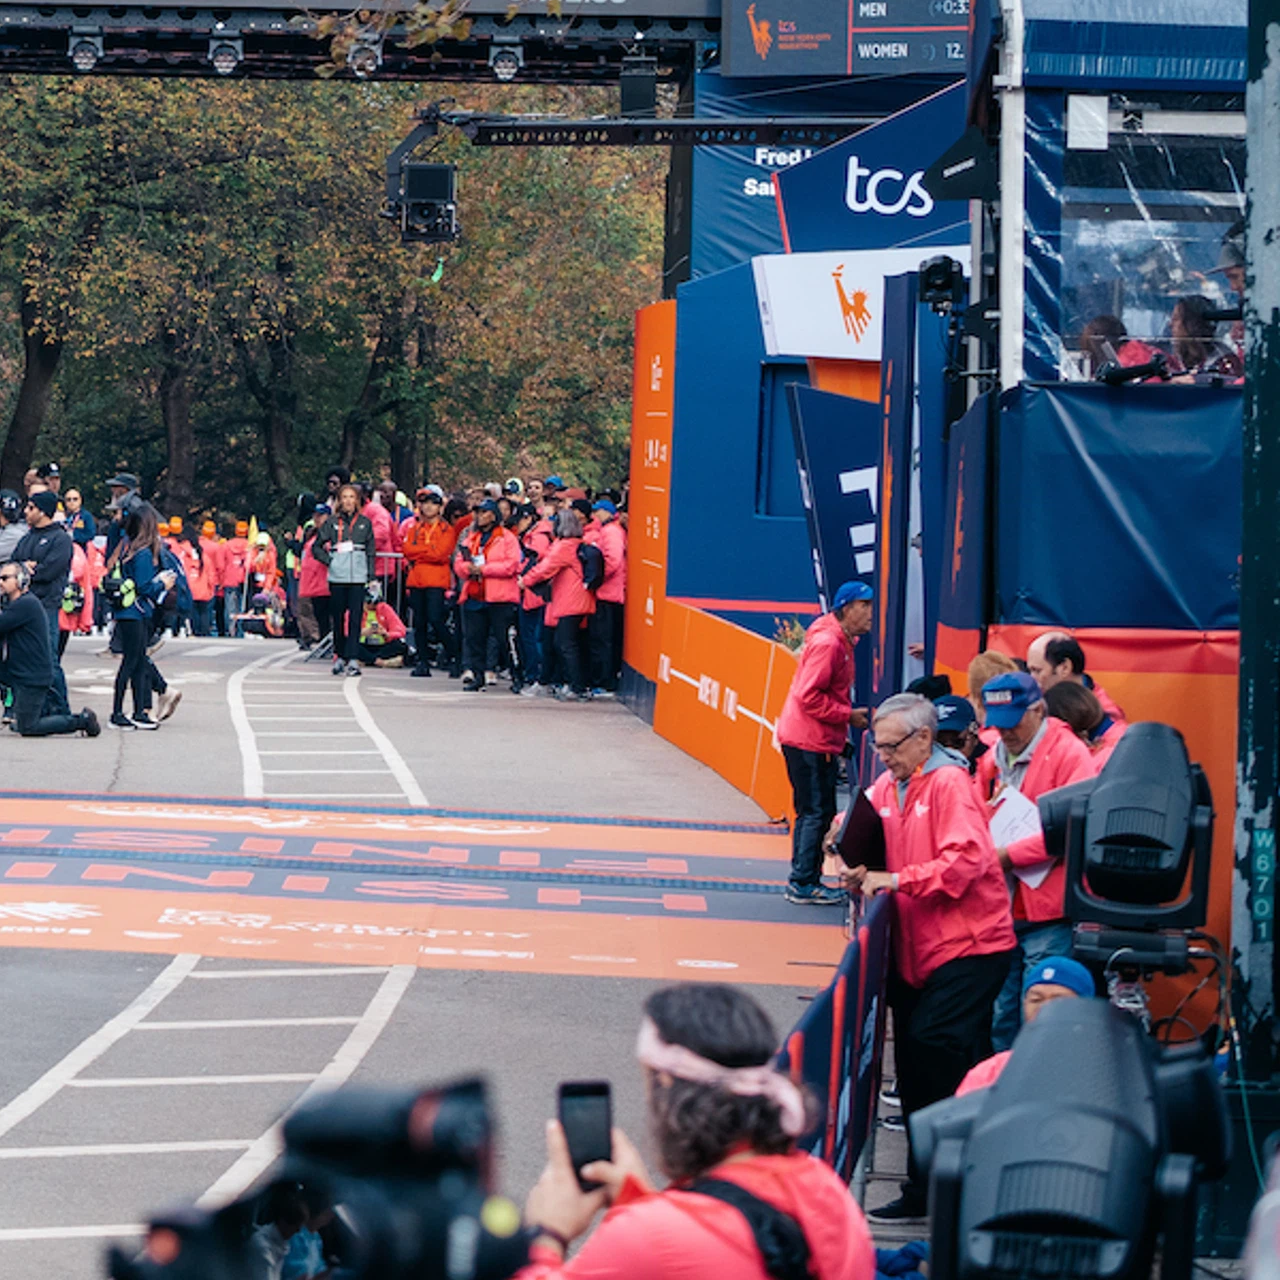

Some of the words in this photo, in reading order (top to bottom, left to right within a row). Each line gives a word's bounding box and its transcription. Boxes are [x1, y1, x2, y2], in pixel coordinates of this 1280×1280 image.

[859, 2, 887, 17] MEN
[858, 43, 908, 58] WOMEN
[755, 147, 802, 165] Fred
[846, 155, 934, 216] tcs
